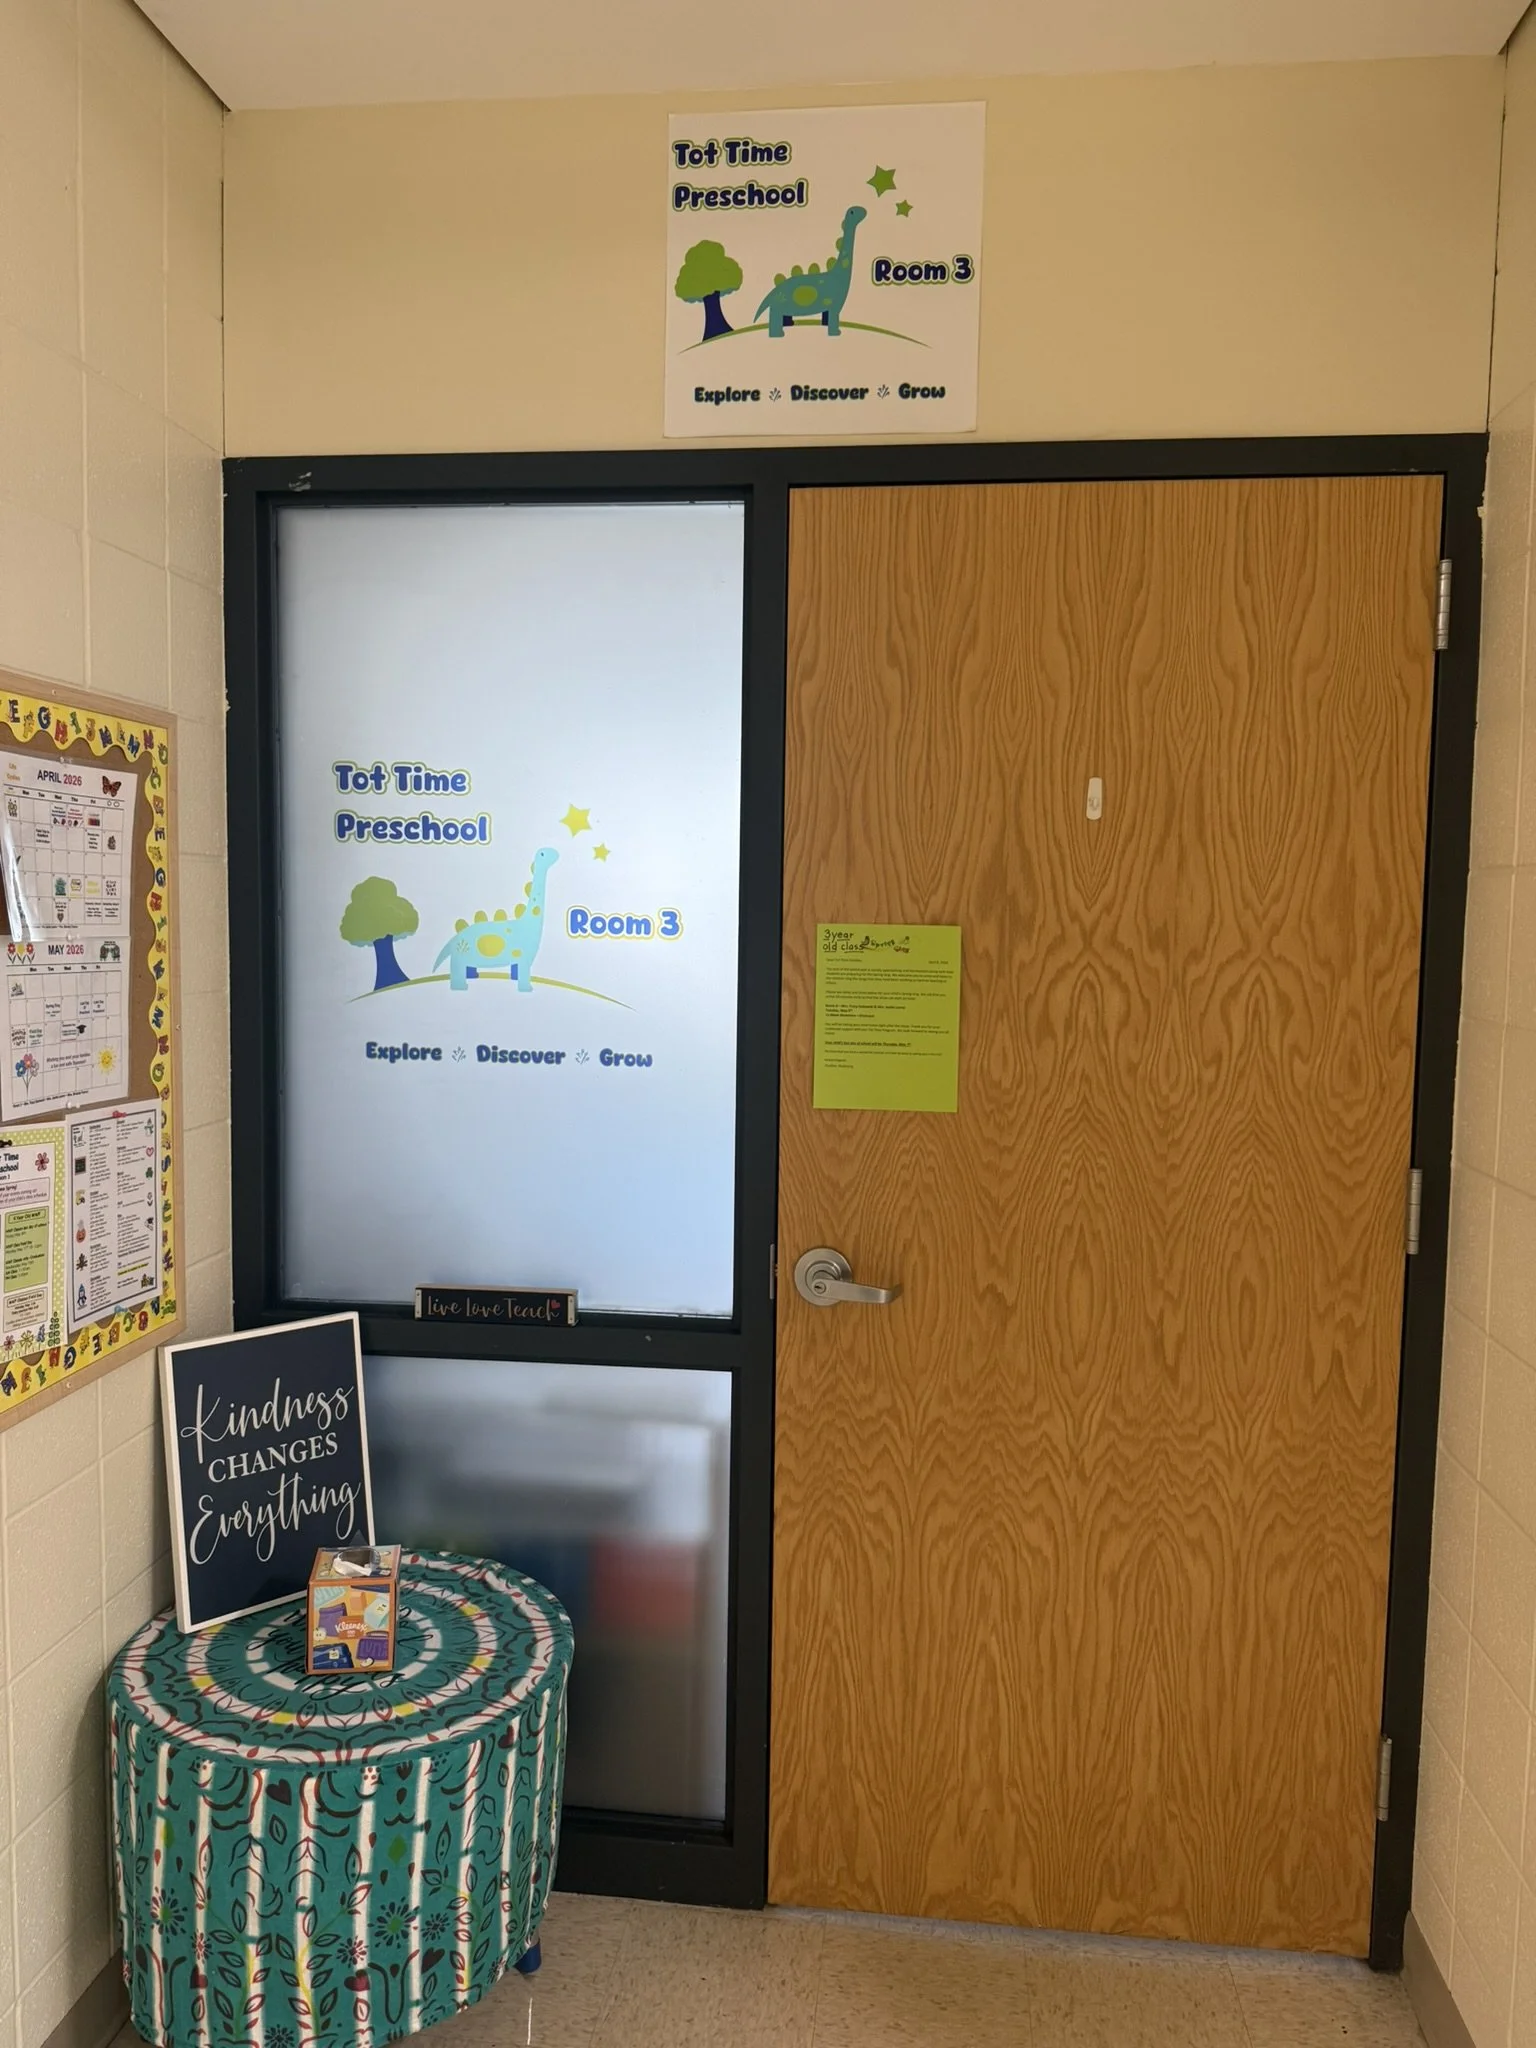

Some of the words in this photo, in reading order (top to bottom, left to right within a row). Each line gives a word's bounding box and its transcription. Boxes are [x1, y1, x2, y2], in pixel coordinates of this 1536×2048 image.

[674, 140, 719, 167] Tot
[724, 139, 790, 164] Time
[673, 180, 807, 210] Preschool
[873, 258, 947, 284] Room
[952, 256, 973, 282] 3
[694, 386, 761, 405] Explore
[790, 384, 869, 401] Discover
[898, 383, 945, 399] Grow
[37, 769, 62, 783] APRIL
[63, 774, 82, 786] 2026
[333, 762, 387, 793] Tot
[392, 765, 470, 794] Time
[335, 811, 490, 843] Preschool
[568, 907, 653, 937] Room
[659, 908, 681, 938] 3
[48, 944, 64, 955] MAY
[66, 944, 84, 955] 2026
[823, 942, 837, 951] old
[841, 942, 864, 952] class
[365, 1041, 443, 1063] Explore
[476, 1044, 567, 1065] Discover
[600, 1048, 653, 1068] Grow
[428, 1295, 462, 1316] Live
[466, 1297, 504, 1318] Love
[503, 1298, 560, 1321] Teach
[180, 1377, 355, 1464] Kindness
[207, 1431, 339, 1483] CHANGES
[189, 1472, 361, 1565] Everything
[334, 1621, 367, 1633] Kleenex
